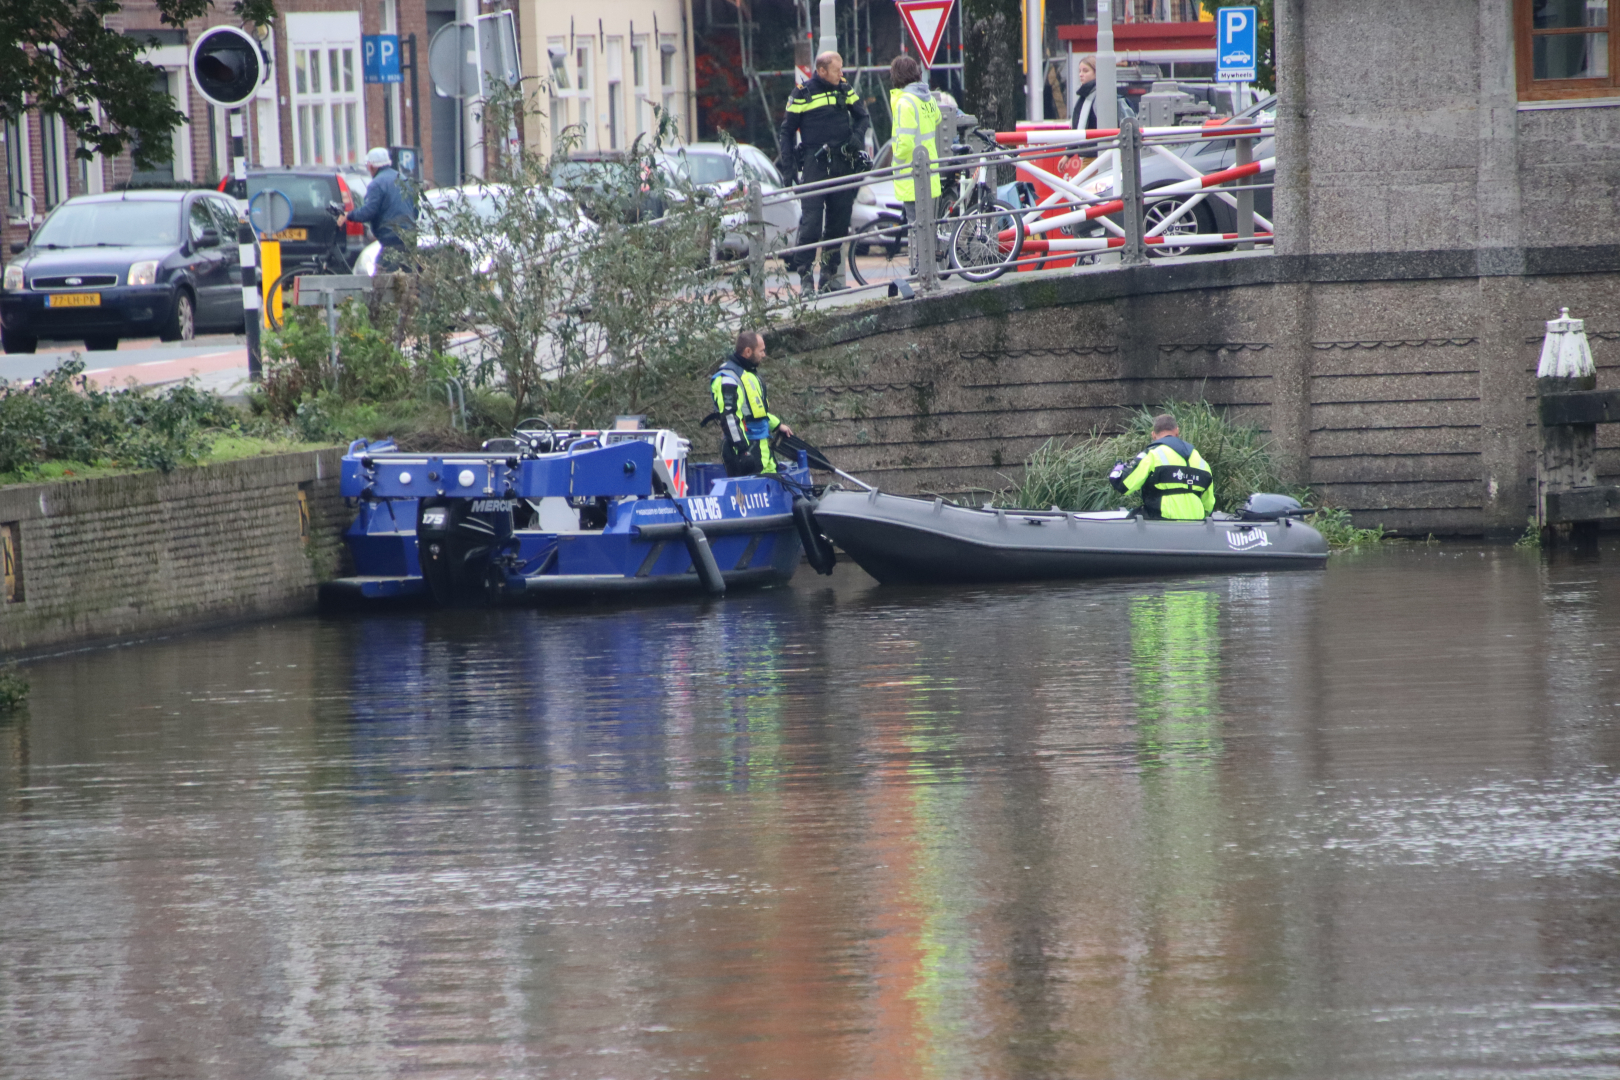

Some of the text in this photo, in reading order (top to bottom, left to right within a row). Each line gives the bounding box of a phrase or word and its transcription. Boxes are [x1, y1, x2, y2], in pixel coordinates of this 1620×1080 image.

[1226, 12, 1248, 44] P
[365, 41, 375, 66] P
[380, 40, 394, 66] P
[1221, 72, 1253, 80] Mywheels
[402, 151, 412, 167] P
[53, 294, 97, 306] 77-LH-PK
[730, 492, 771, 518] POLITIE
[421, 513, 446, 525] 175
[1226, 527, 1269, 547] Whaly
